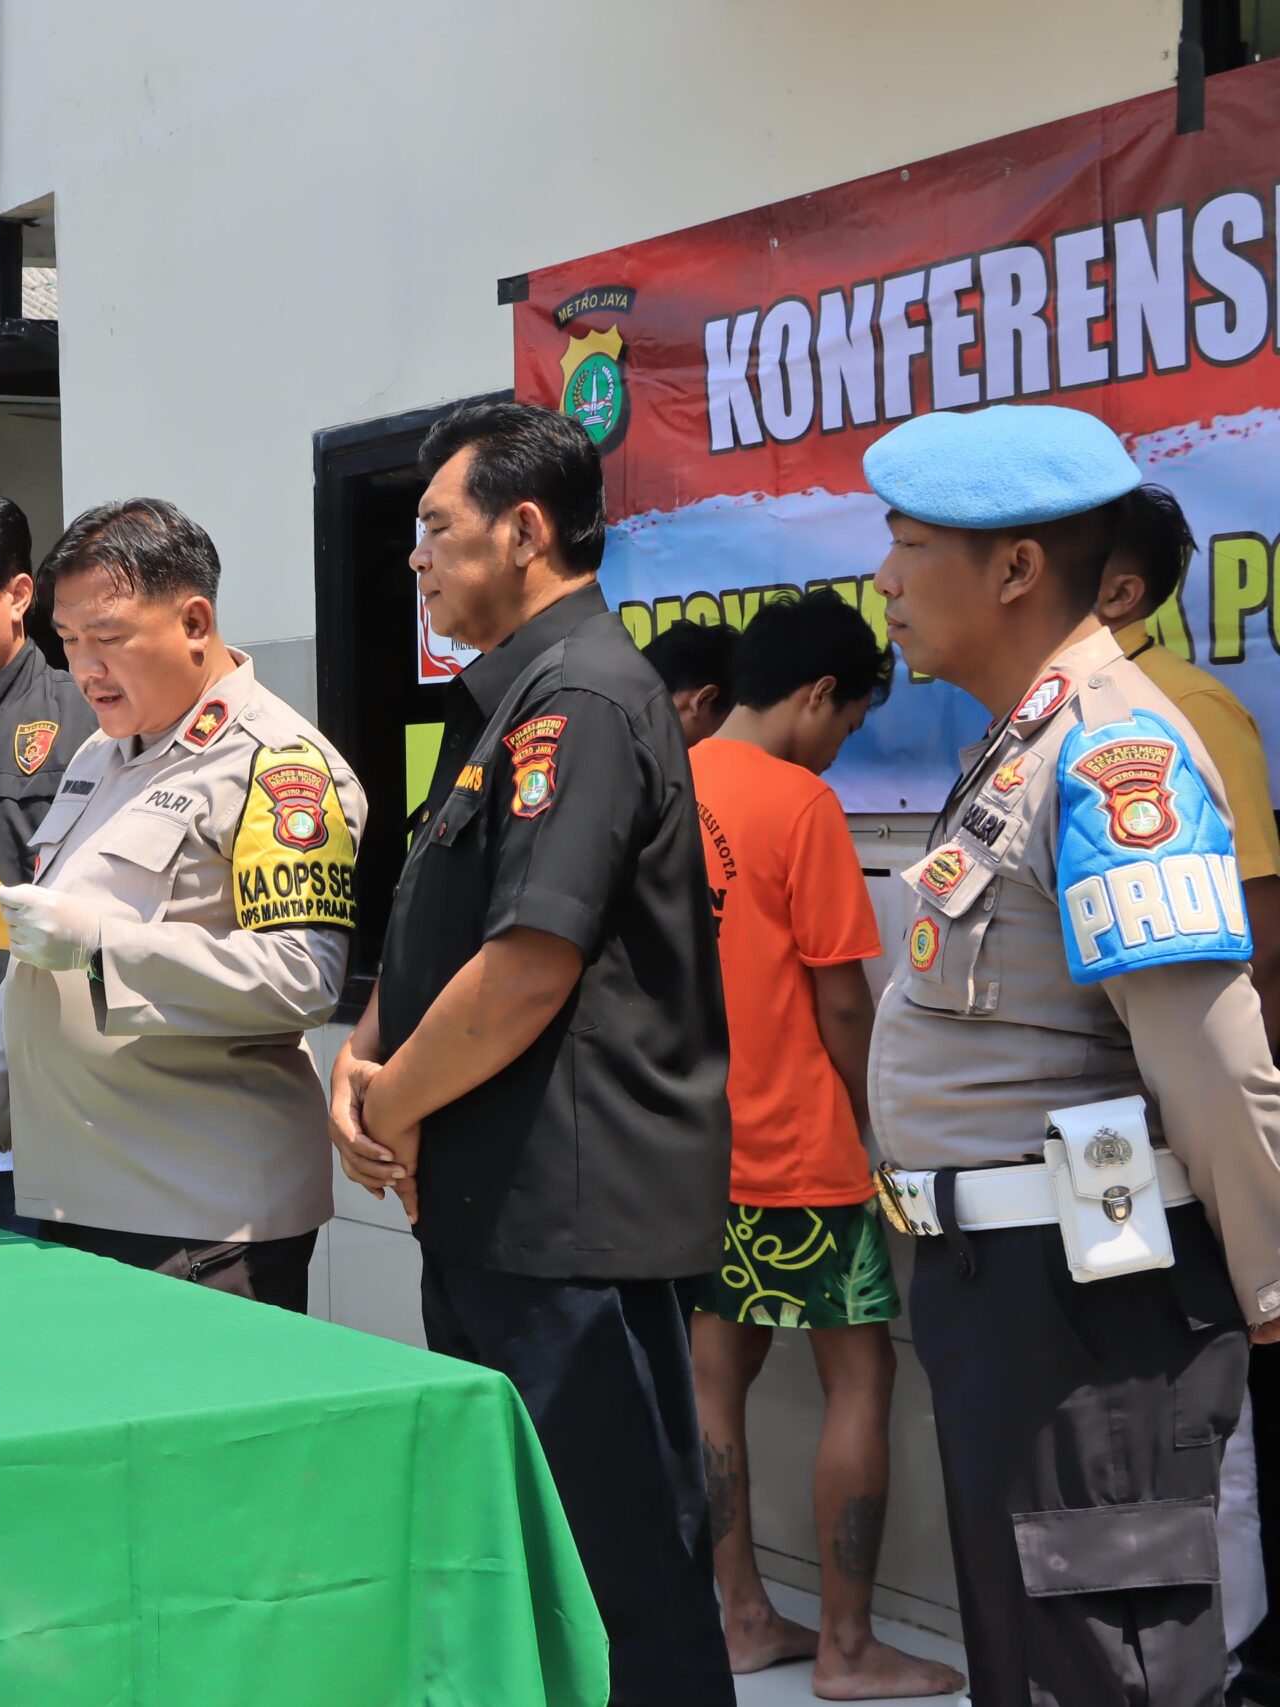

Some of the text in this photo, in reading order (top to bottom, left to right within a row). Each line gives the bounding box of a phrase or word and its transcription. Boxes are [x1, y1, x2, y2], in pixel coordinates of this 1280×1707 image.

[558, 292, 628, 323] METRO JAYA
[702, 184, 1280, 452] KONFERENS
[1208, 530, 1280, 666] P
[509, 719, 562, 746] POLRES METRO
[1086, 745, 1169, 770] POLRES METRO
[1091, 752, 1163, 774] BEKASI KOTA
[266, 769, 322, 783] POLRES METRO
[1107, 770, 1158, 785] METRO JAYA
[145, 790, 194, 814] POLRI
[278, 788, 300, 798] METRO
[696, 801, 720, 837] EKASI
[713, 833, 738, 881] KOTA
[238, 860, 357, 907] KA OPS SE
[241, 906, 261, 928] OPS
[261, 897, 315, 922] MANTAP
[315, 898, 349, 919] PRAJA
